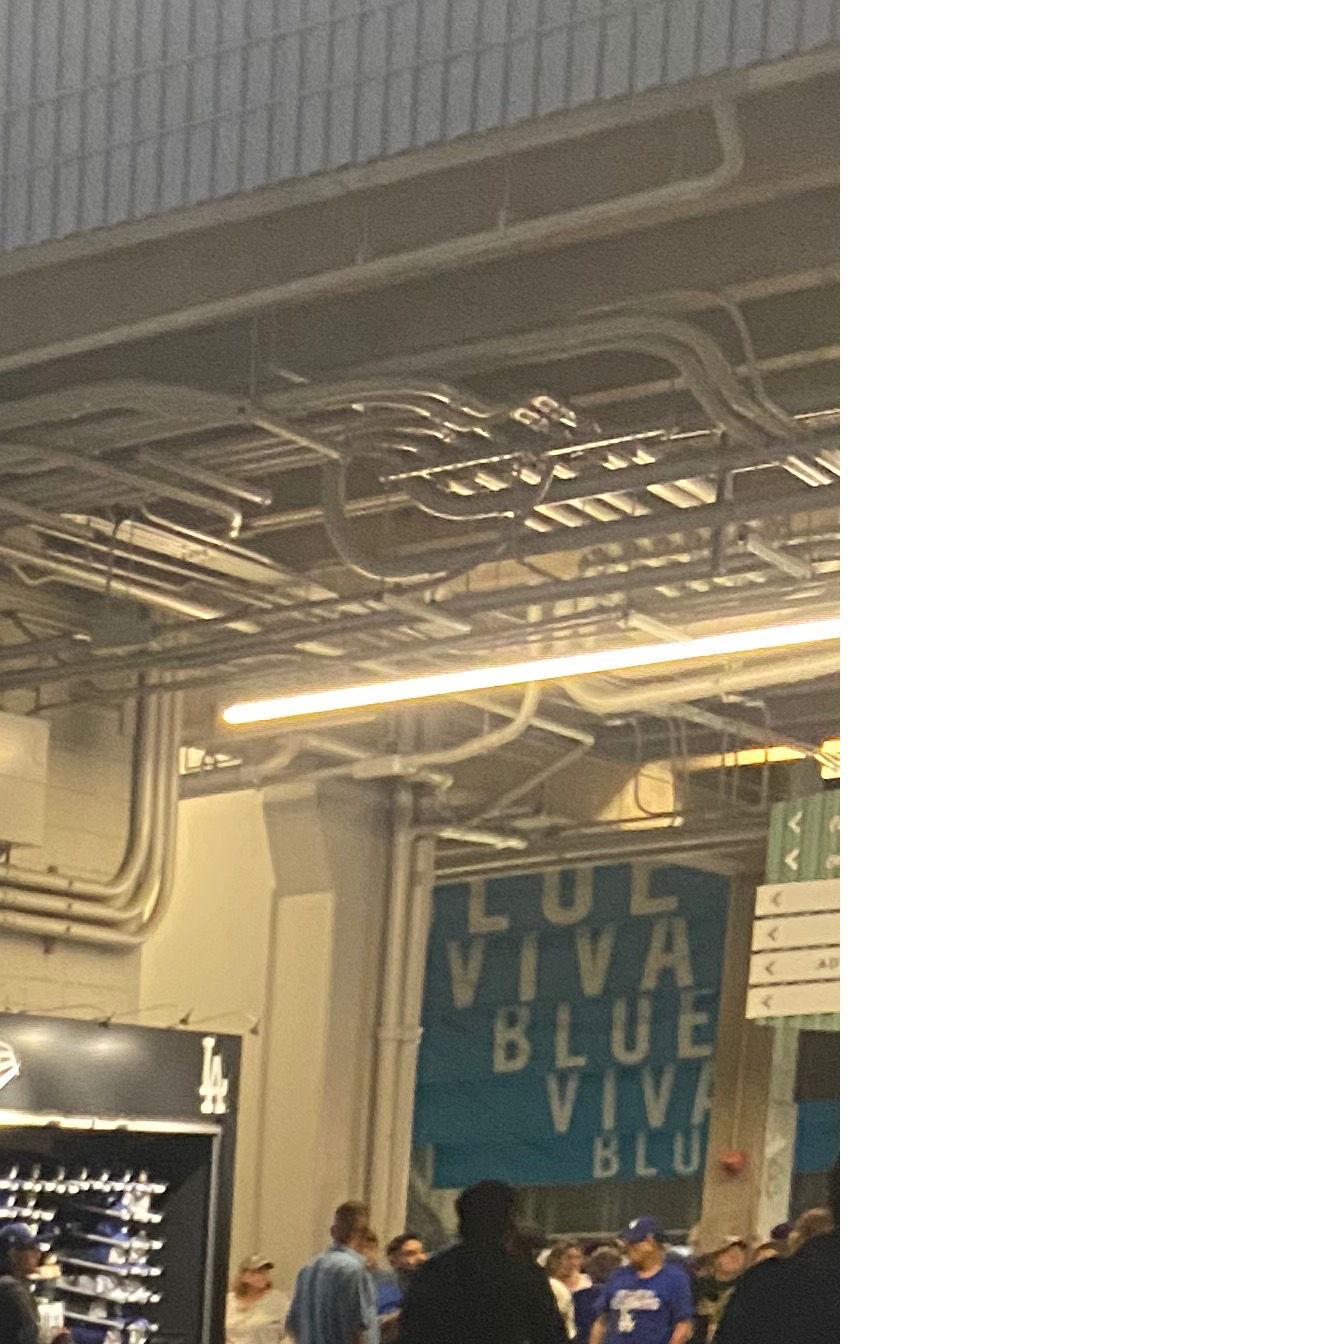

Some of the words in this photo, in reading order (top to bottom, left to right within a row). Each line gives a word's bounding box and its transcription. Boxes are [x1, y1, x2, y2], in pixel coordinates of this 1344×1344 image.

[447, 917, 694, 1008] VIVA
[493, 990, 711, 1072] BLUE
[199, 1037, 228, 1114] LA
